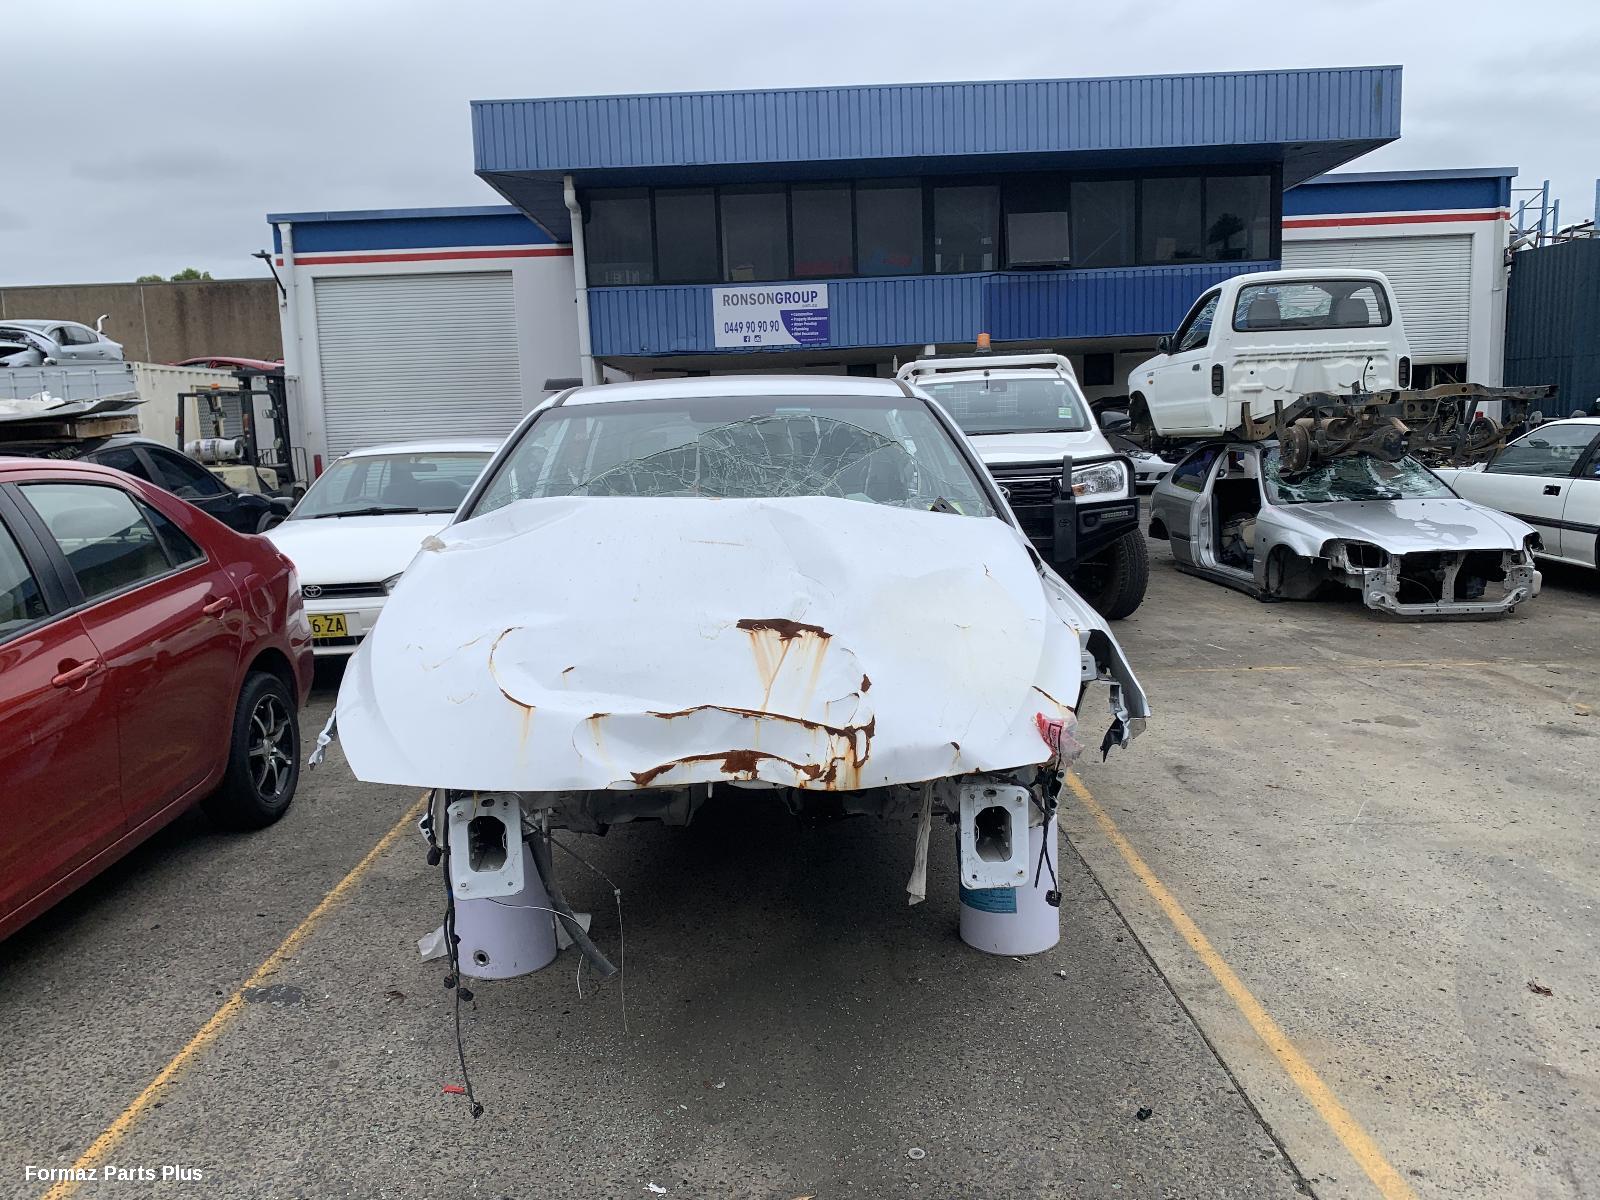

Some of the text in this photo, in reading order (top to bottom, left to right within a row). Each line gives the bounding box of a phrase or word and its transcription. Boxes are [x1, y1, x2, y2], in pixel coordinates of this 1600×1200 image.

[723, 290, 818, 306] RONSONGROUP
[724, 321, 744, 334] 0449
[746, 321, 755, 333] 90
[758, 320, 767, 333] 90
[769, 320, 780, 332] 90
